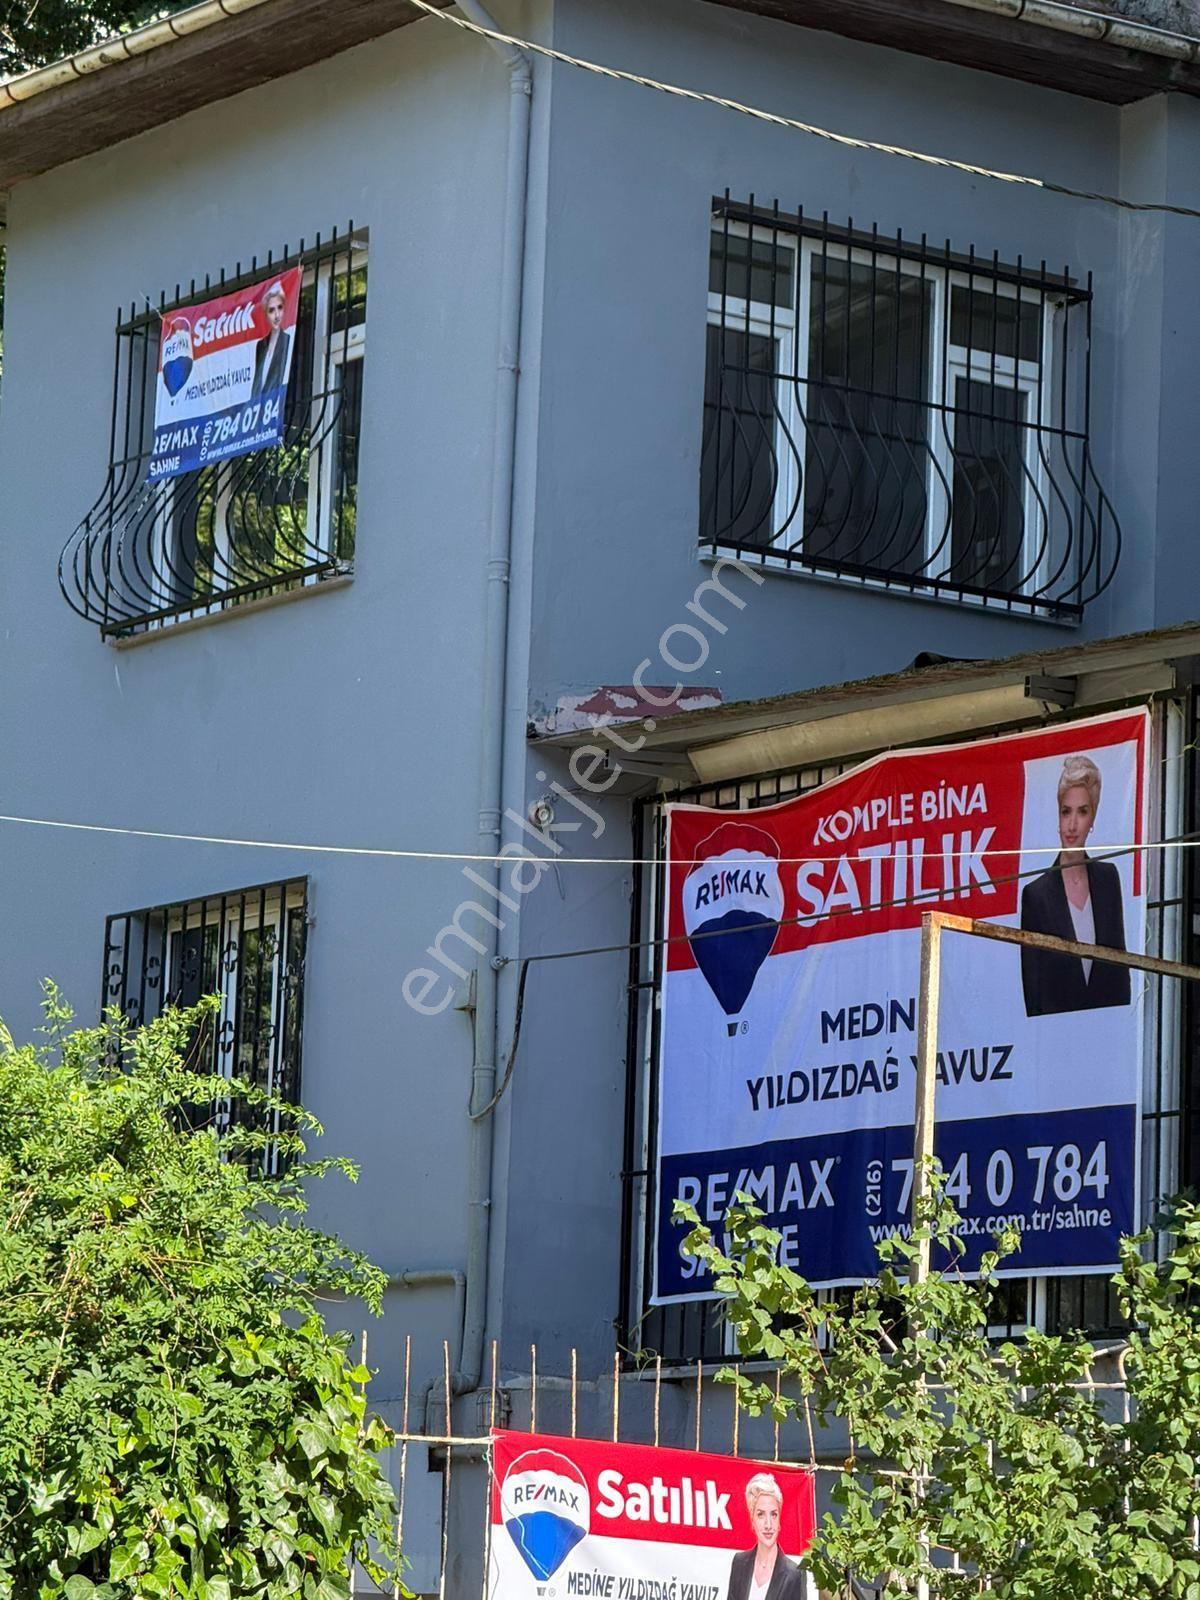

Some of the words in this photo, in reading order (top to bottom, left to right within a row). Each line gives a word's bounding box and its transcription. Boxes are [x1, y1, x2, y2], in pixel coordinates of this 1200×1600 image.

[194, 301, 256, 347] Satılık
[229, 366, 251, 388] YAVUZ
[200, 421, 213, 461] (0216)
[211, 412, 242, 444] 784
[242, 403, 261, 433] 07
[263, 395, 280, 426] 84
[150, 456, 181, 477] SAHNE
[813, 791, 914, 846] KOMPLE
[921, 779, 988, 820] BİNA
[694, 869, 770, 911] RE/MAX
[797, 826, 997, 928] SATILIK
[746, 1046, 899, 1112] YILDIZDAĞ
[909, 1044, 1015, 1086] AVUZ
[678, 1157, 835, 1225] RE/MAX
[866, 1160, 883, 1217] (216)
[891, 1152, 972, 1215] 74
[985, 1149, 1014, 1208] 0
[1026, 1140, 1110, 1205] 784
[513, 1483, 580, 1512] RE/MAX
[595, 1469, 734, 1531] Satılık
[567, 1568, 616, 1598] MEDİNE
